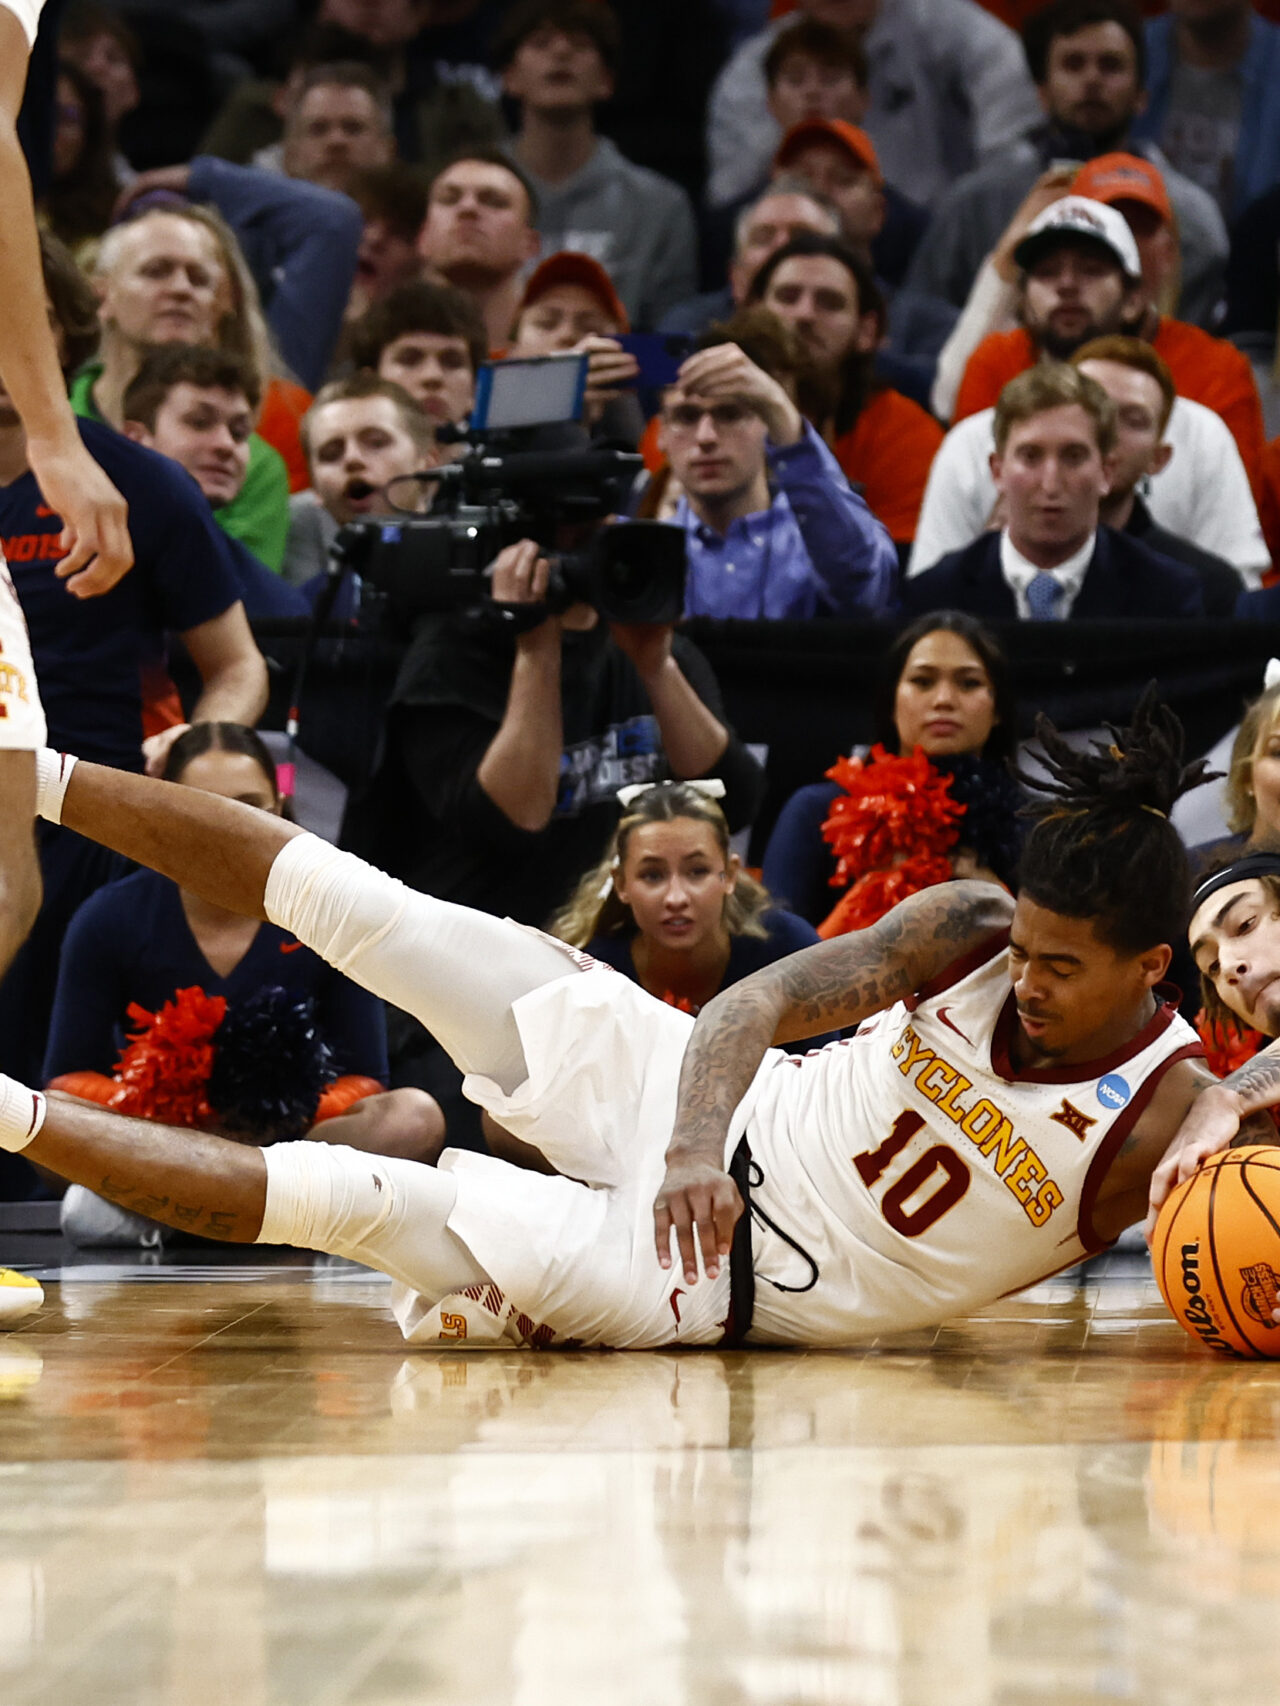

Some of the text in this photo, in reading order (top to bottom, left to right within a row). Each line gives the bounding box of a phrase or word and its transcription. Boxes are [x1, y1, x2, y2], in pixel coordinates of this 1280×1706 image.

[1099, 1083, 1126, 1106] NCAA
[851, 1107, 972, 1238] 10
[1181, 1242, 1243, 1358] Wilson
